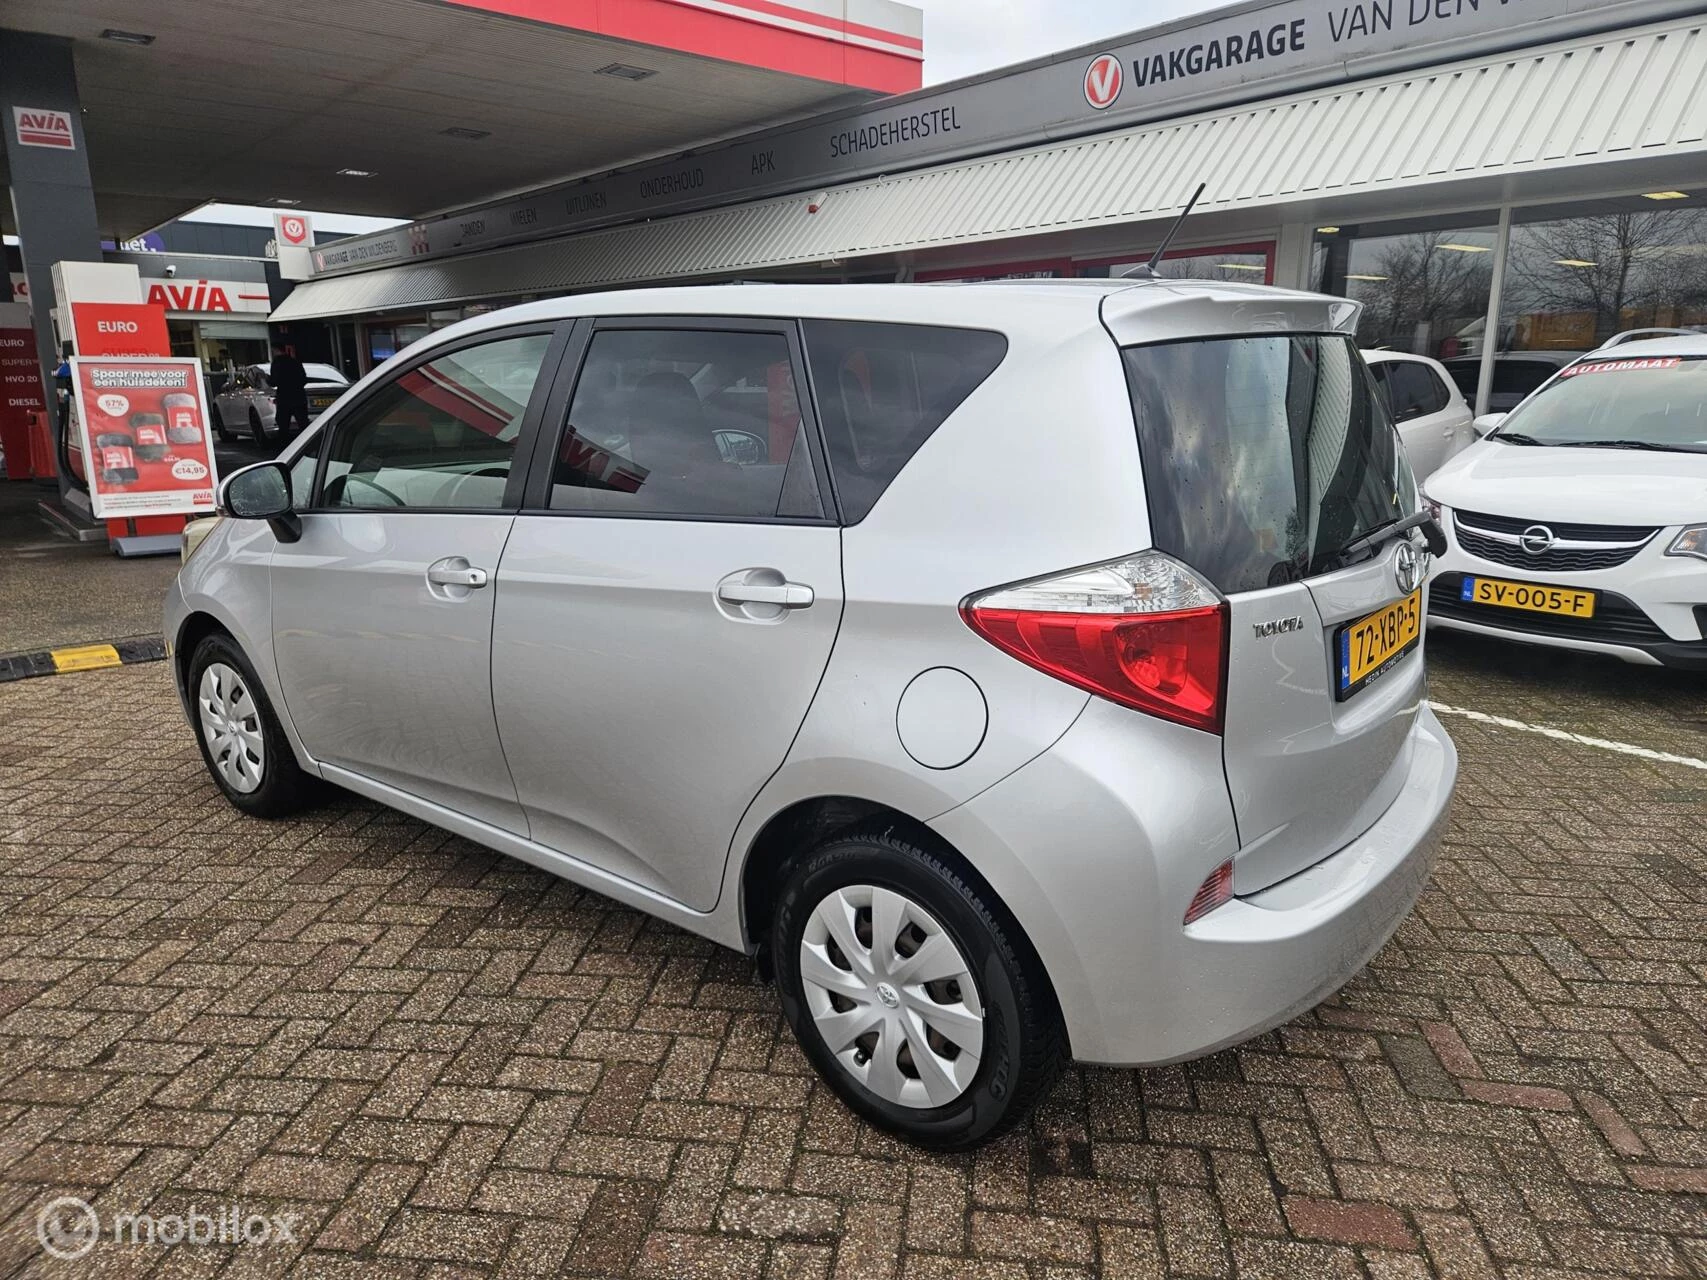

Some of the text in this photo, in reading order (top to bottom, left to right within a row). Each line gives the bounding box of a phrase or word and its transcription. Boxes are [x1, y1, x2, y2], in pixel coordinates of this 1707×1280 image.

[1133, 19, 1306, 87] VAKGARAGE
[1328, 0, 1392, 42] VAN
[19, 112, 69, 132] AVIA
[509, 207, 538, 226] WIELEN
[639, 168, 704, 199] ONDERHOUD
[751, 150, 776, 175] APK
[830, 106, 961, 158] SCHADEHERSTEL
[147, 279, 232, 311] AVIA
[97, 320, 138, 333] EURO
[92, 369, 187, 379] Spaar mee voor
[1567, 359, 1677, 375] AUTOMAAT
[5, 375, 38, 383] HVO 20
[94, 378, 186, 387] een huisdeken!
[8, 398, 41, 406] DIESEL
[1464, 582, 1587, 613] NL SV-005-F
[1252, 616, 1304, 638] TOYOTA
[1356, 597, 1416, 671] 72-XBP-5
[1342, 665, 1349, 678] NL
